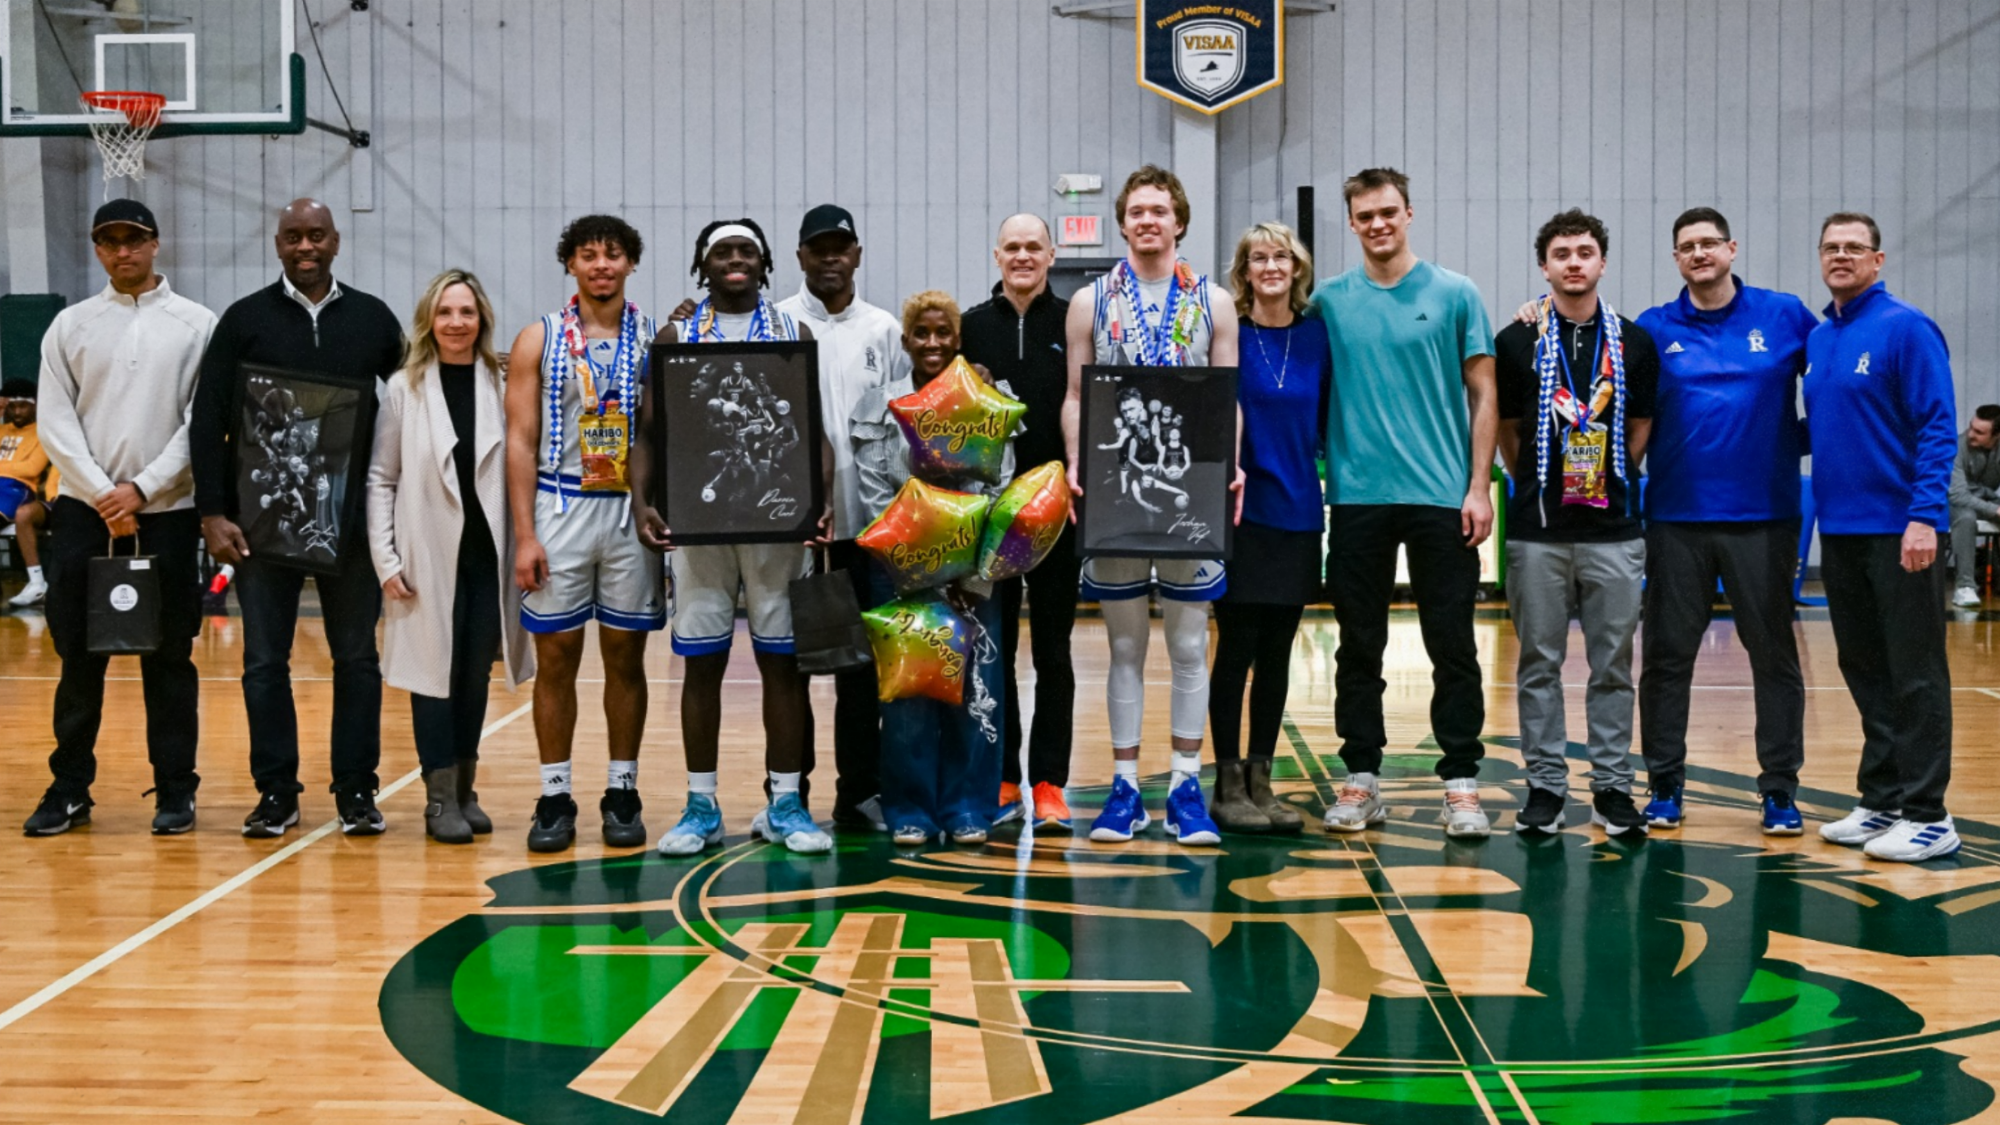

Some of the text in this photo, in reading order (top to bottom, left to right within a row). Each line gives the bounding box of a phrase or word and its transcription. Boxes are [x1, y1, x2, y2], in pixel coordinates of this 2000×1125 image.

[1156, 5, 1262, 29] Proud Member of VISAA
[1183, 35, 1235, 50] VISAA
[1065, 216, 1097, 242] EXIT
[584, 428, 622, 438] HARIBO
[914, 409, 1010, 453] Congrats!
[884, 515, 978, 573] Congrats!
